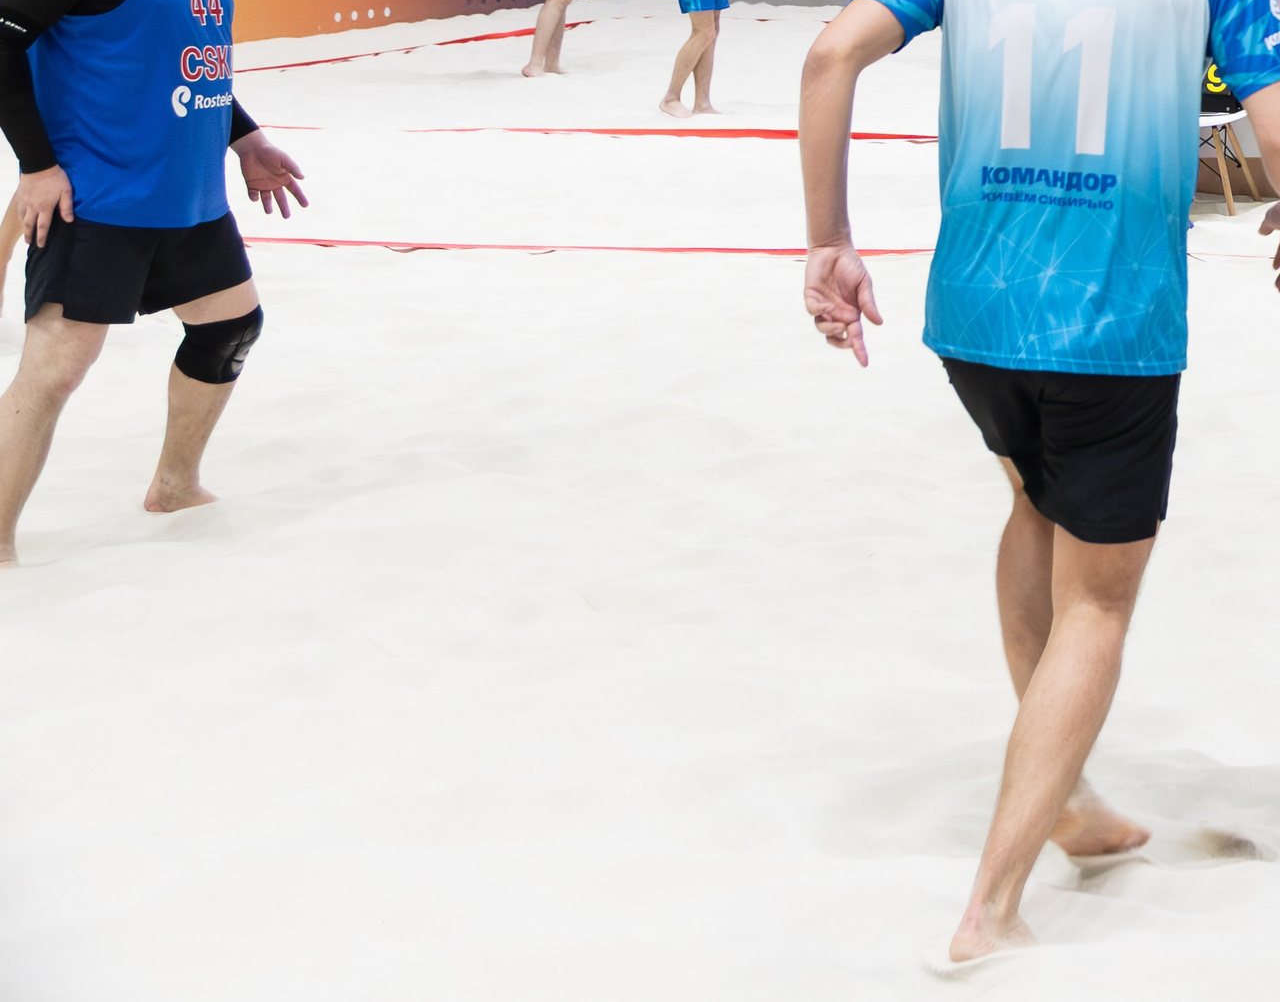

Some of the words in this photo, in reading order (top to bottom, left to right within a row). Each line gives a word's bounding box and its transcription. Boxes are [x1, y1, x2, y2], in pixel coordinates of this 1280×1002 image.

[180, 45, 233, 82] CSK
[988, 3, 1117, 156] 11
[981, 166, 1117, 194] КОМАНДОР
[1038, 194, 1114, 211] СИБИРЬЮ
